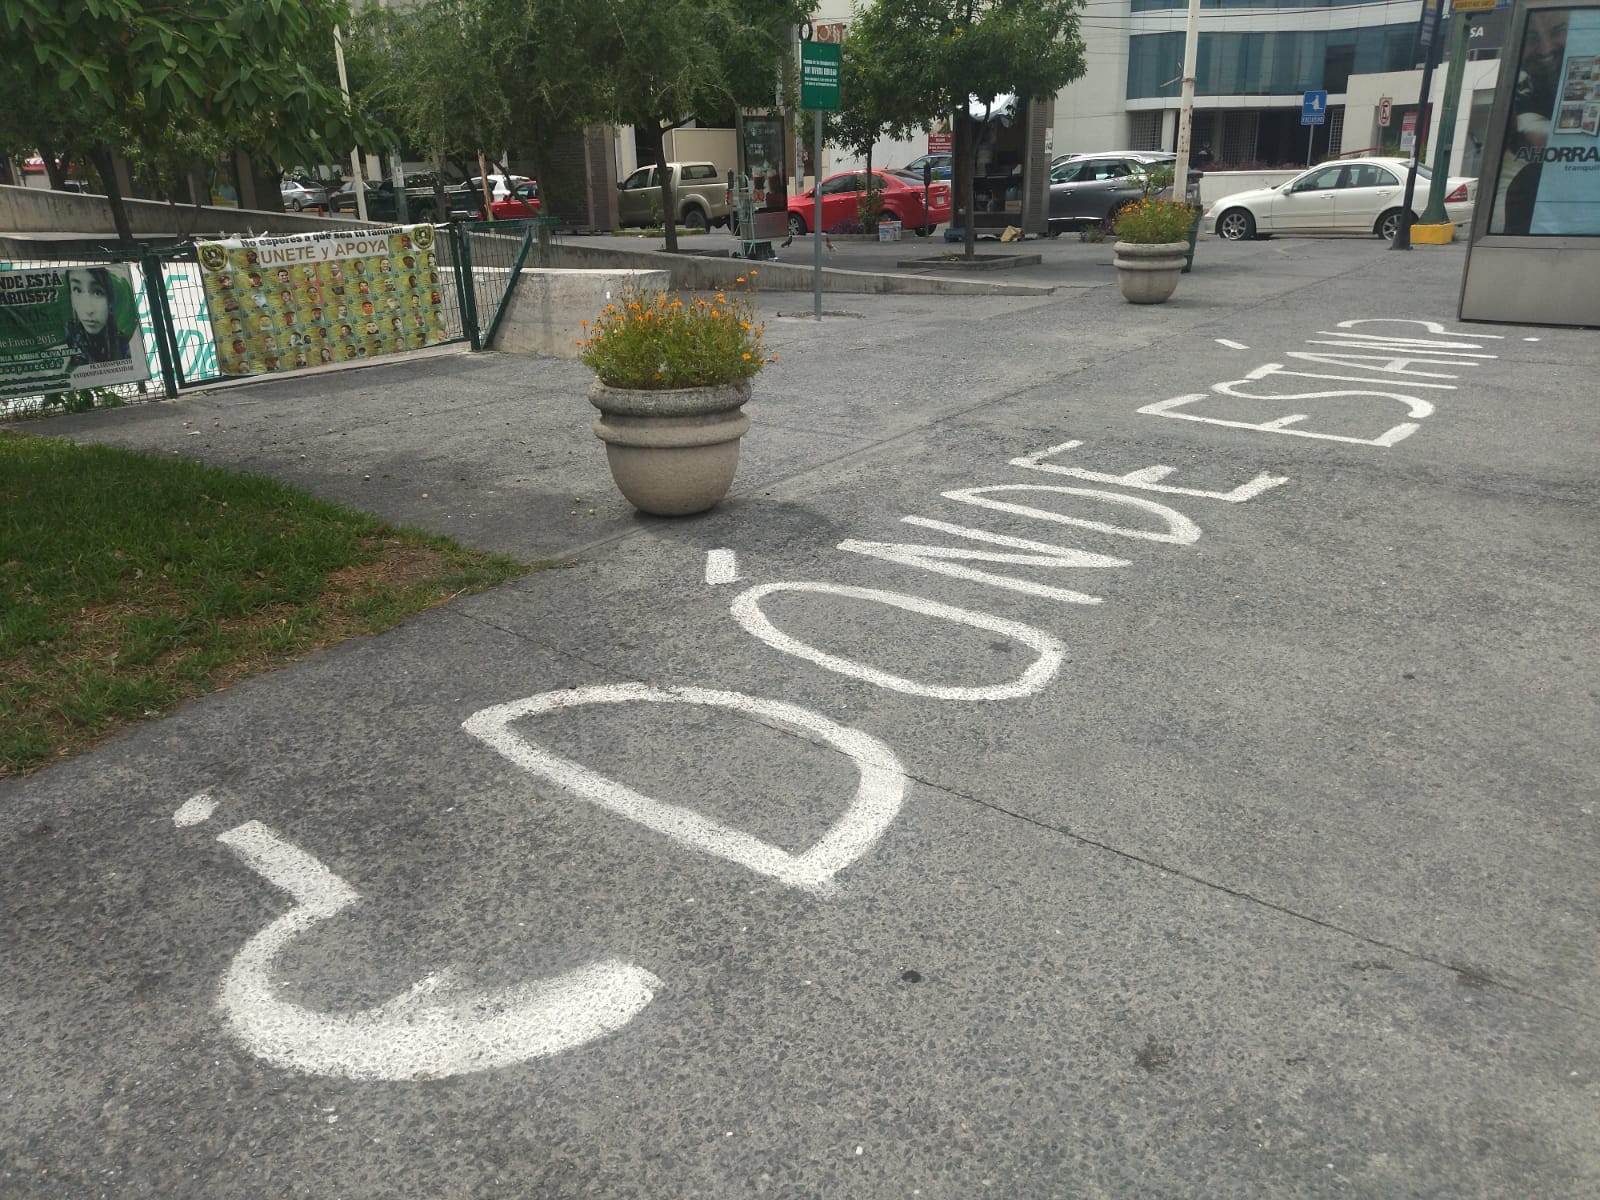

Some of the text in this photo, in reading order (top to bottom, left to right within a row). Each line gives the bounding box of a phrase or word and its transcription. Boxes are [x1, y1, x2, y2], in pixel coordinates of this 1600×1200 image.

[1516, 145, 1600, 163] AHORRA
[240, 239, 257, 248] No
[258, 233, 302, 247] esperes
[260, 239, 388, 264] UNETE y APOYA
[25, 270, 62, 288] ESTÁ
[36, 333, 57, 345] 2015
